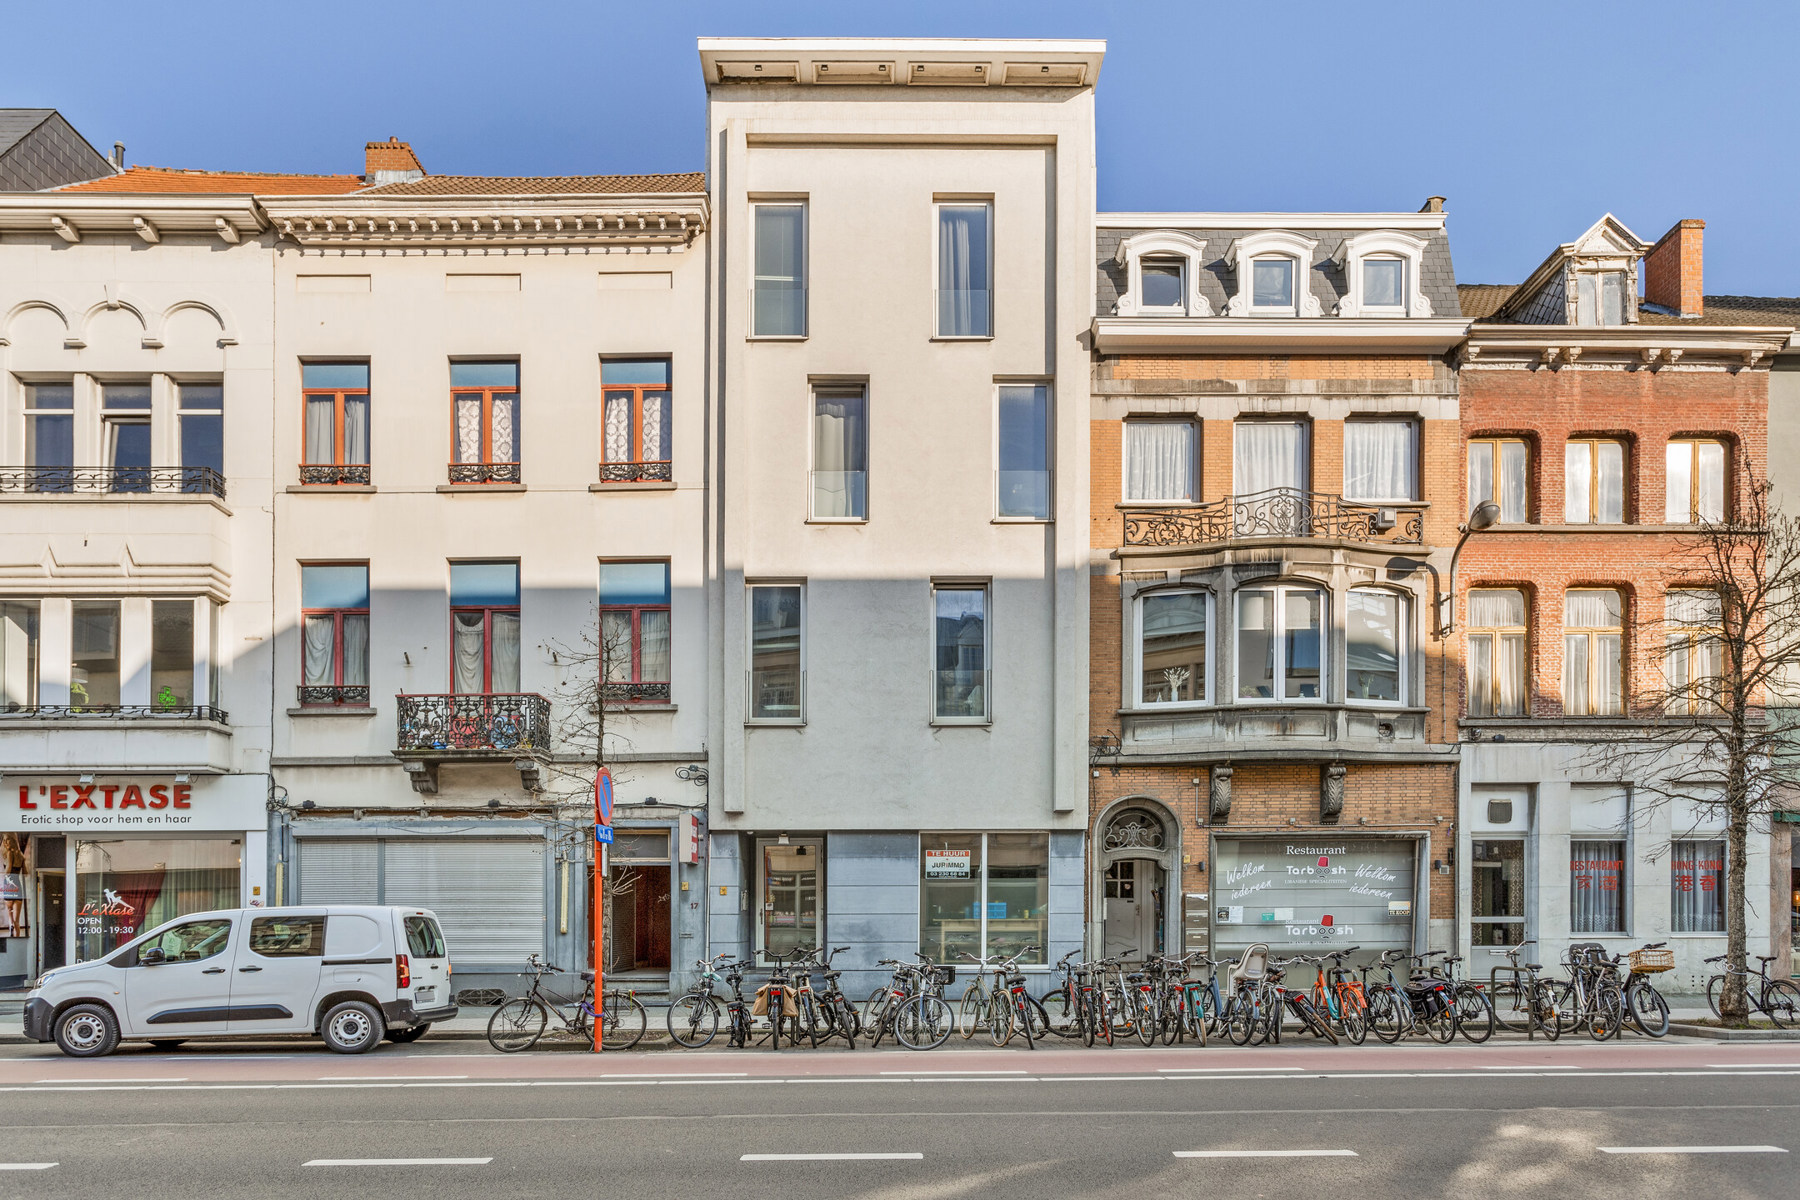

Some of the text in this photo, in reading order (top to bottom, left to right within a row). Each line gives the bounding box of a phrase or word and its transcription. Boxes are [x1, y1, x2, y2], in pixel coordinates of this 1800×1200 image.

[19, 784, 192, 809] L'EXTASE
[21, 814, 192, 826] Erotic shop voor hem en haar
[1286, 845, 1347, 855] Restaurant
[1286, 865, 1347, 875] Tarboosh
[1354, 863, 1397, 882] Welkom
[1570, 860, 1624, 871] RESTAURANT
[1226, 862, 1265, 885] Welkom
[1231, 879, 1272, 900] iedereen
[1349, 882, 1393, 900] iedereen
[1285, 925, 1354, 936] Tarboosh
